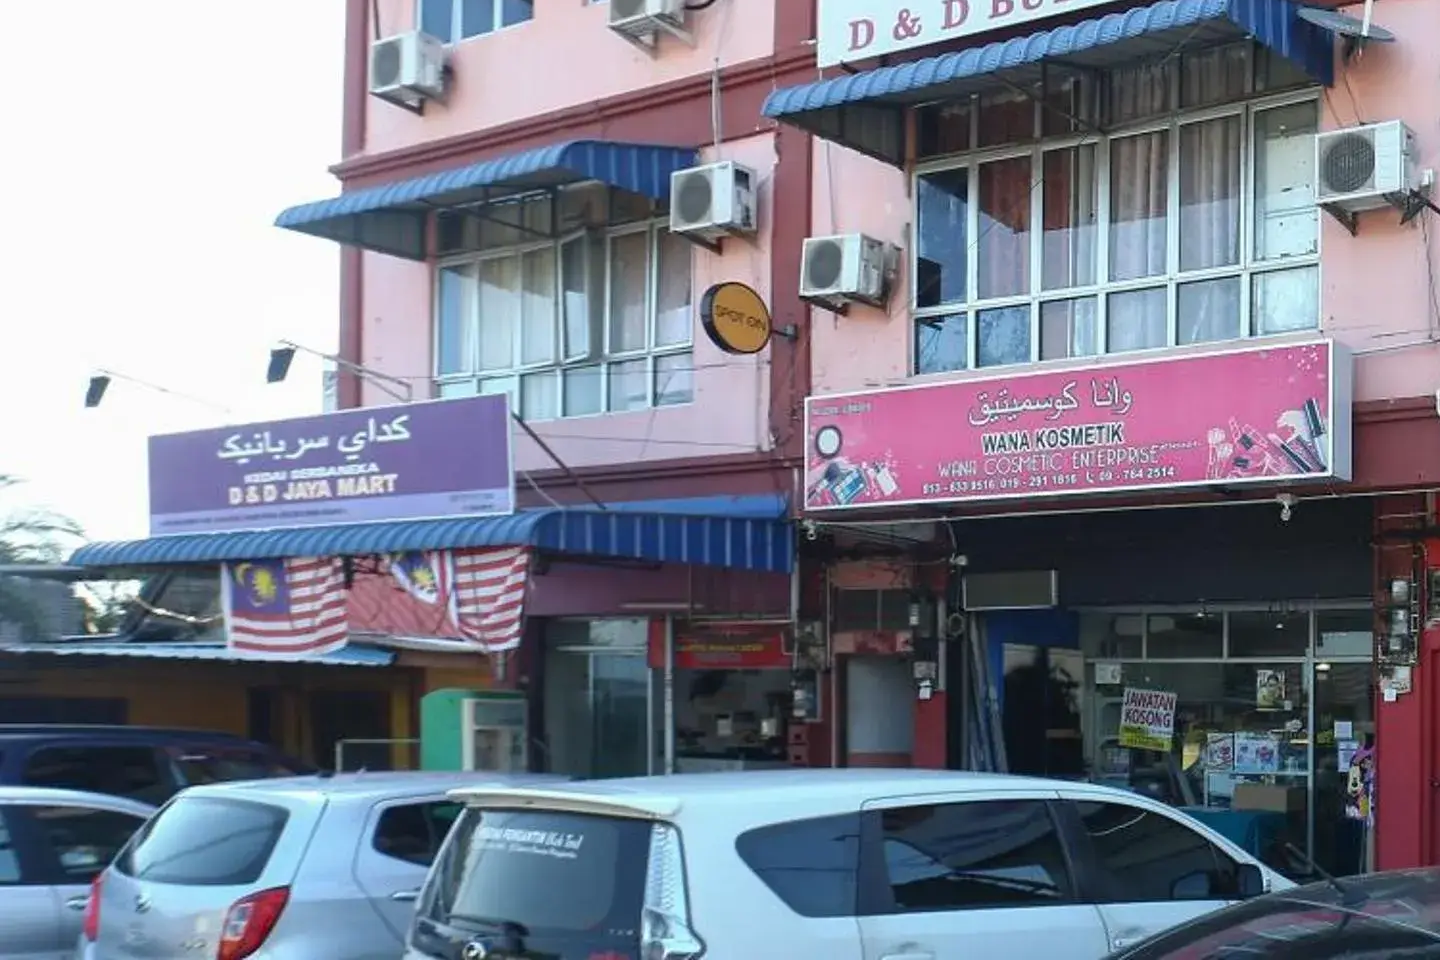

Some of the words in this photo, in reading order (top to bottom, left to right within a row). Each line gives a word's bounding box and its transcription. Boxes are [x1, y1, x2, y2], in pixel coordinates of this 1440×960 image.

[849, 17, 875, 51] D
[892, 8, 922, 41] &
[982, 429, 1031, 456] WANA
[1035, 422, 1124, 451] KOSMETIK
[984, 449, 1066, 475] COSMETIC
[1072, 444, 1160, 470] ENTERPRISE
[228, 487, 243, 505] D
[245, 486, 260, 504] &
[263, 484, 277, 502] D
[282, 479, 333, 500] JAYA
[337, 473, 399, 497] MART
[1123, 689, 1175, 710] JAWATAN
[1123, 708, 1171, 728] KOSONG
